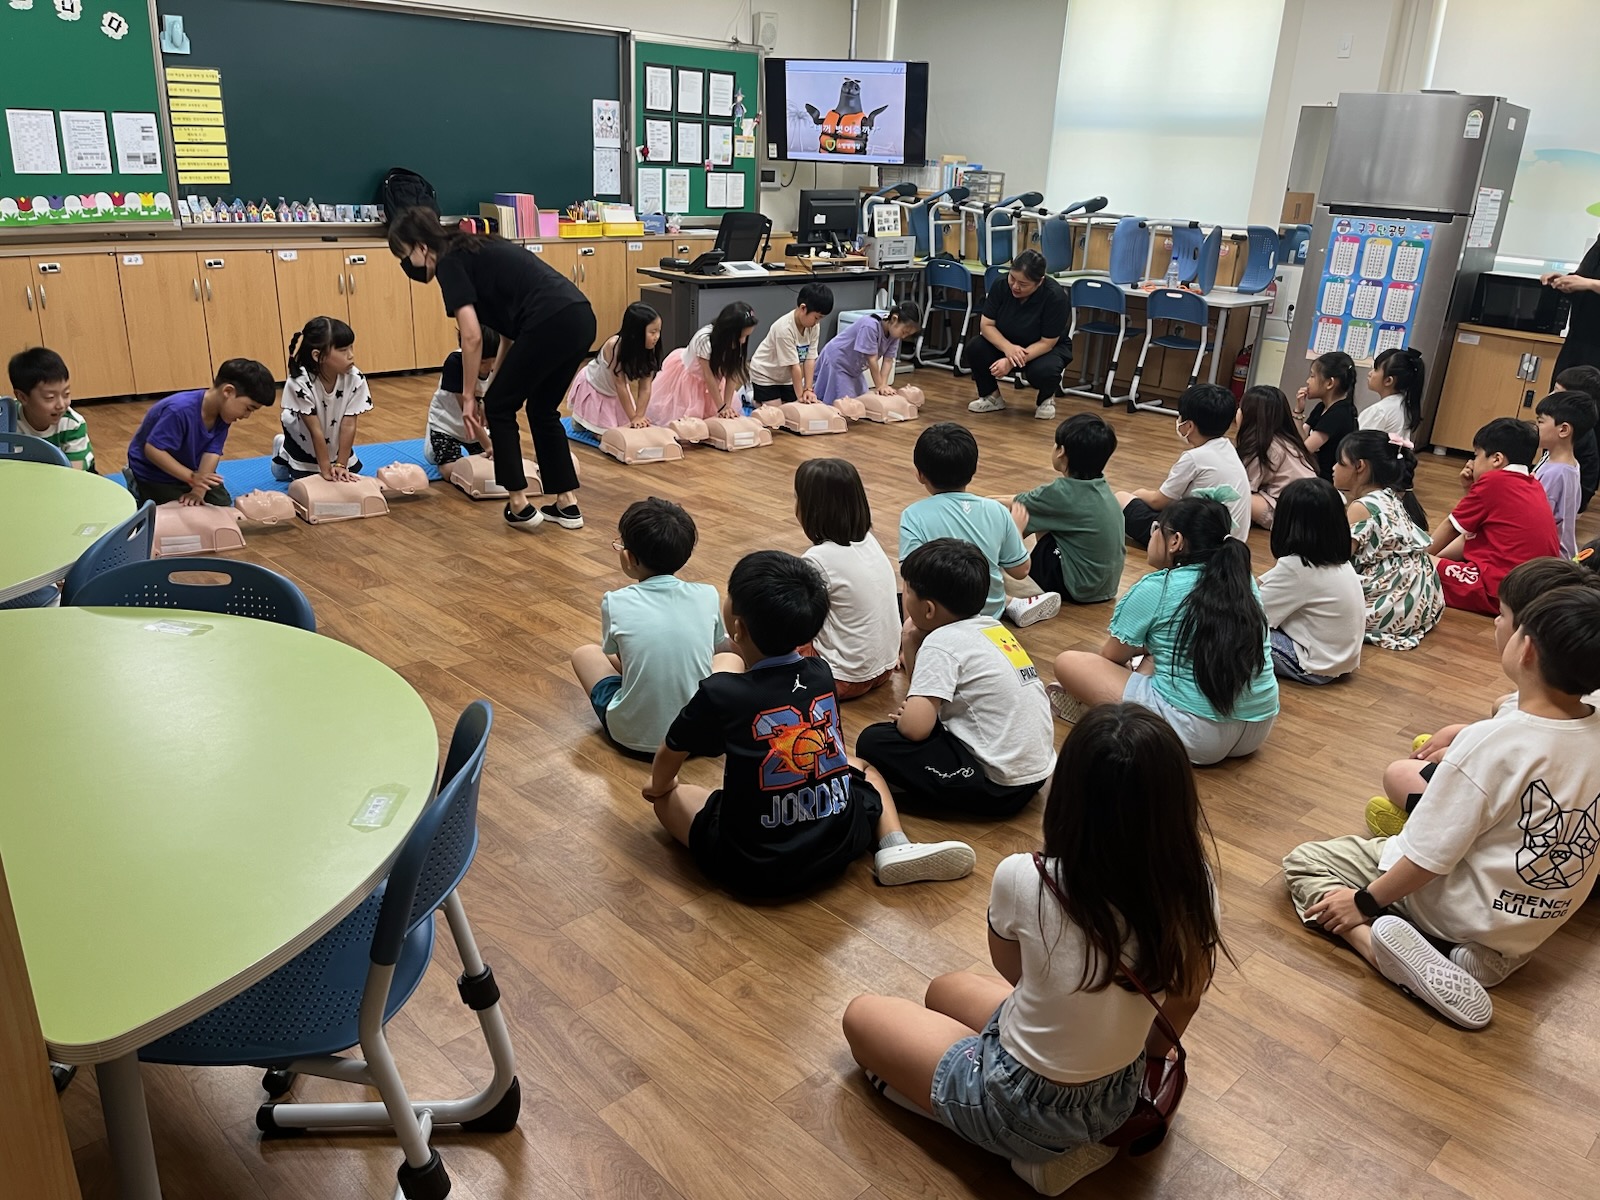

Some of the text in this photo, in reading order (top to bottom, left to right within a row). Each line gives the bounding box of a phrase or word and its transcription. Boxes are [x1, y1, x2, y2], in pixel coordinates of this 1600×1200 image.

[1358, 222, 1406, 237] 구구단 공부
[751, 691, 850, 791] 23
[1492, 899, 1568, 919] BULLDOG
[1499, 889, 1573, 909] FRENCH
